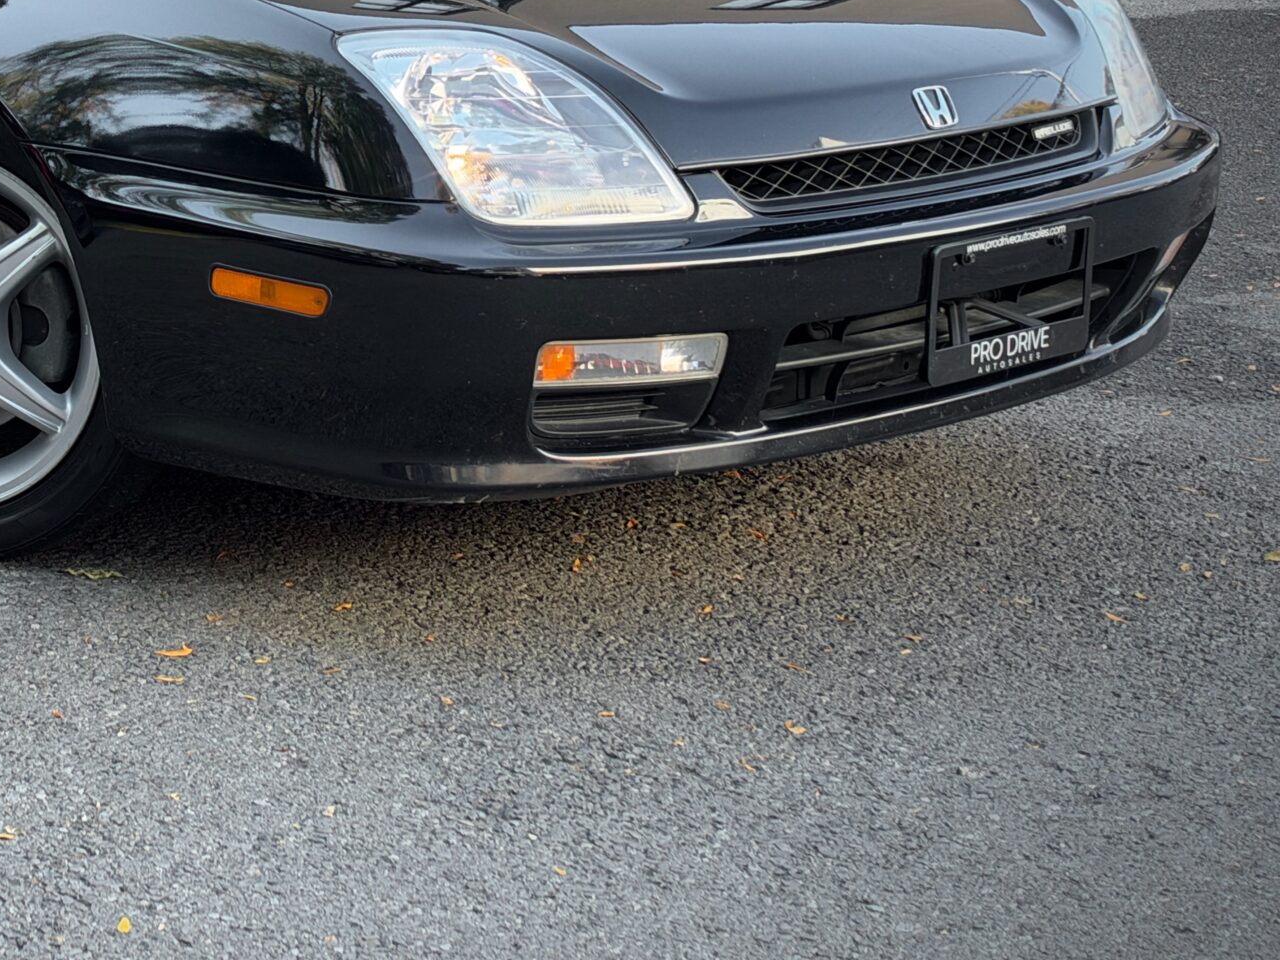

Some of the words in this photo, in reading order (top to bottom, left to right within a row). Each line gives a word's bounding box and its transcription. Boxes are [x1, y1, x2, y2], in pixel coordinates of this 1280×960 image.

[970, 338, 1003, 365] PRO
[1007, 326, 1050, 356] DRIVE
[978, 351, 1041, 374] AUTOSALES
